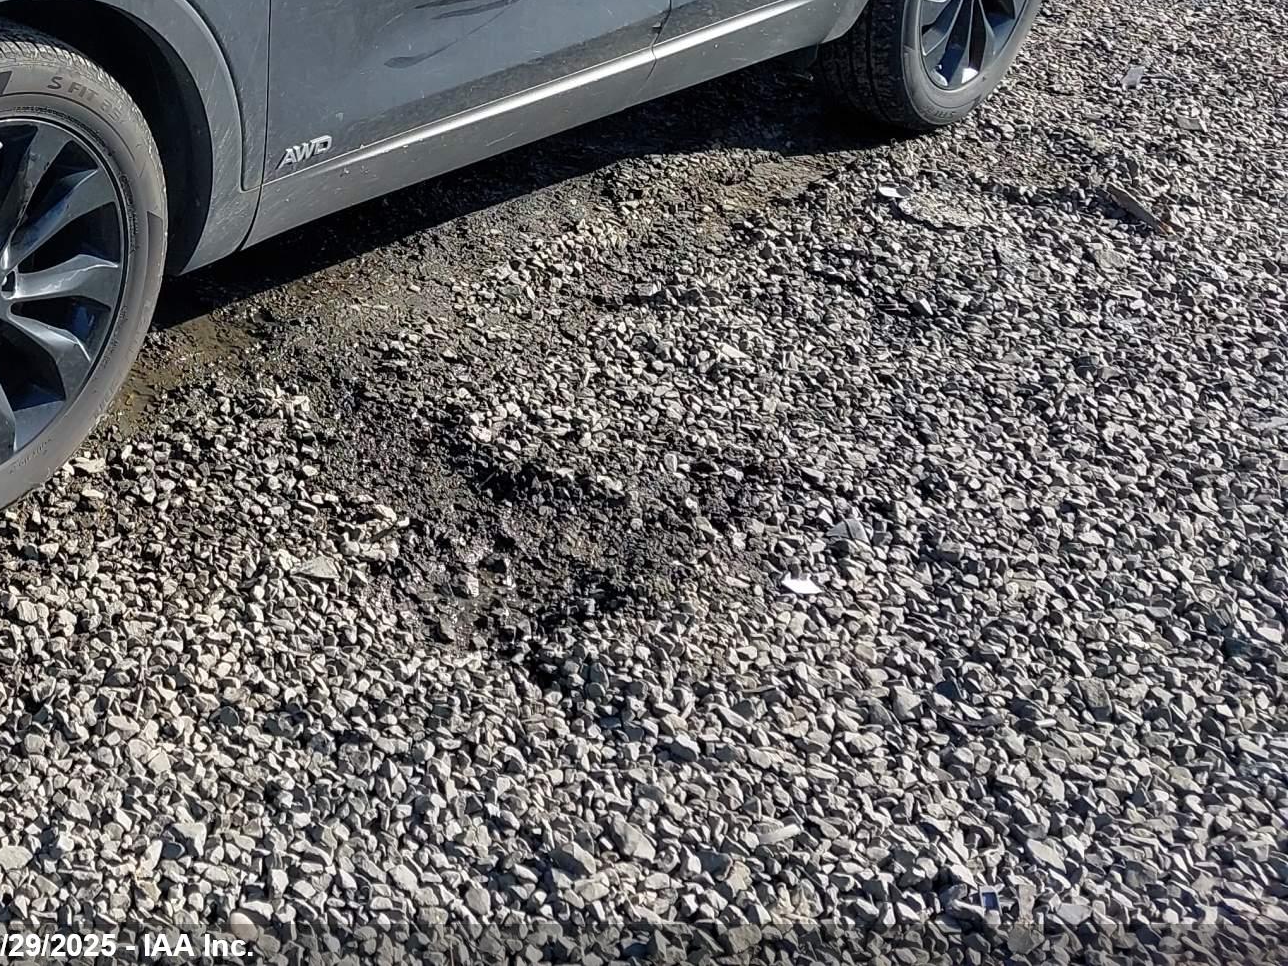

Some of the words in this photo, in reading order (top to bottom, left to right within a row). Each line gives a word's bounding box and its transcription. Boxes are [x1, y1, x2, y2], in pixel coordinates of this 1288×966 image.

[47, 76, 64, 90] S
[68, 81, 99, 101] FIT
[275, 135, 333, 170] AWD
